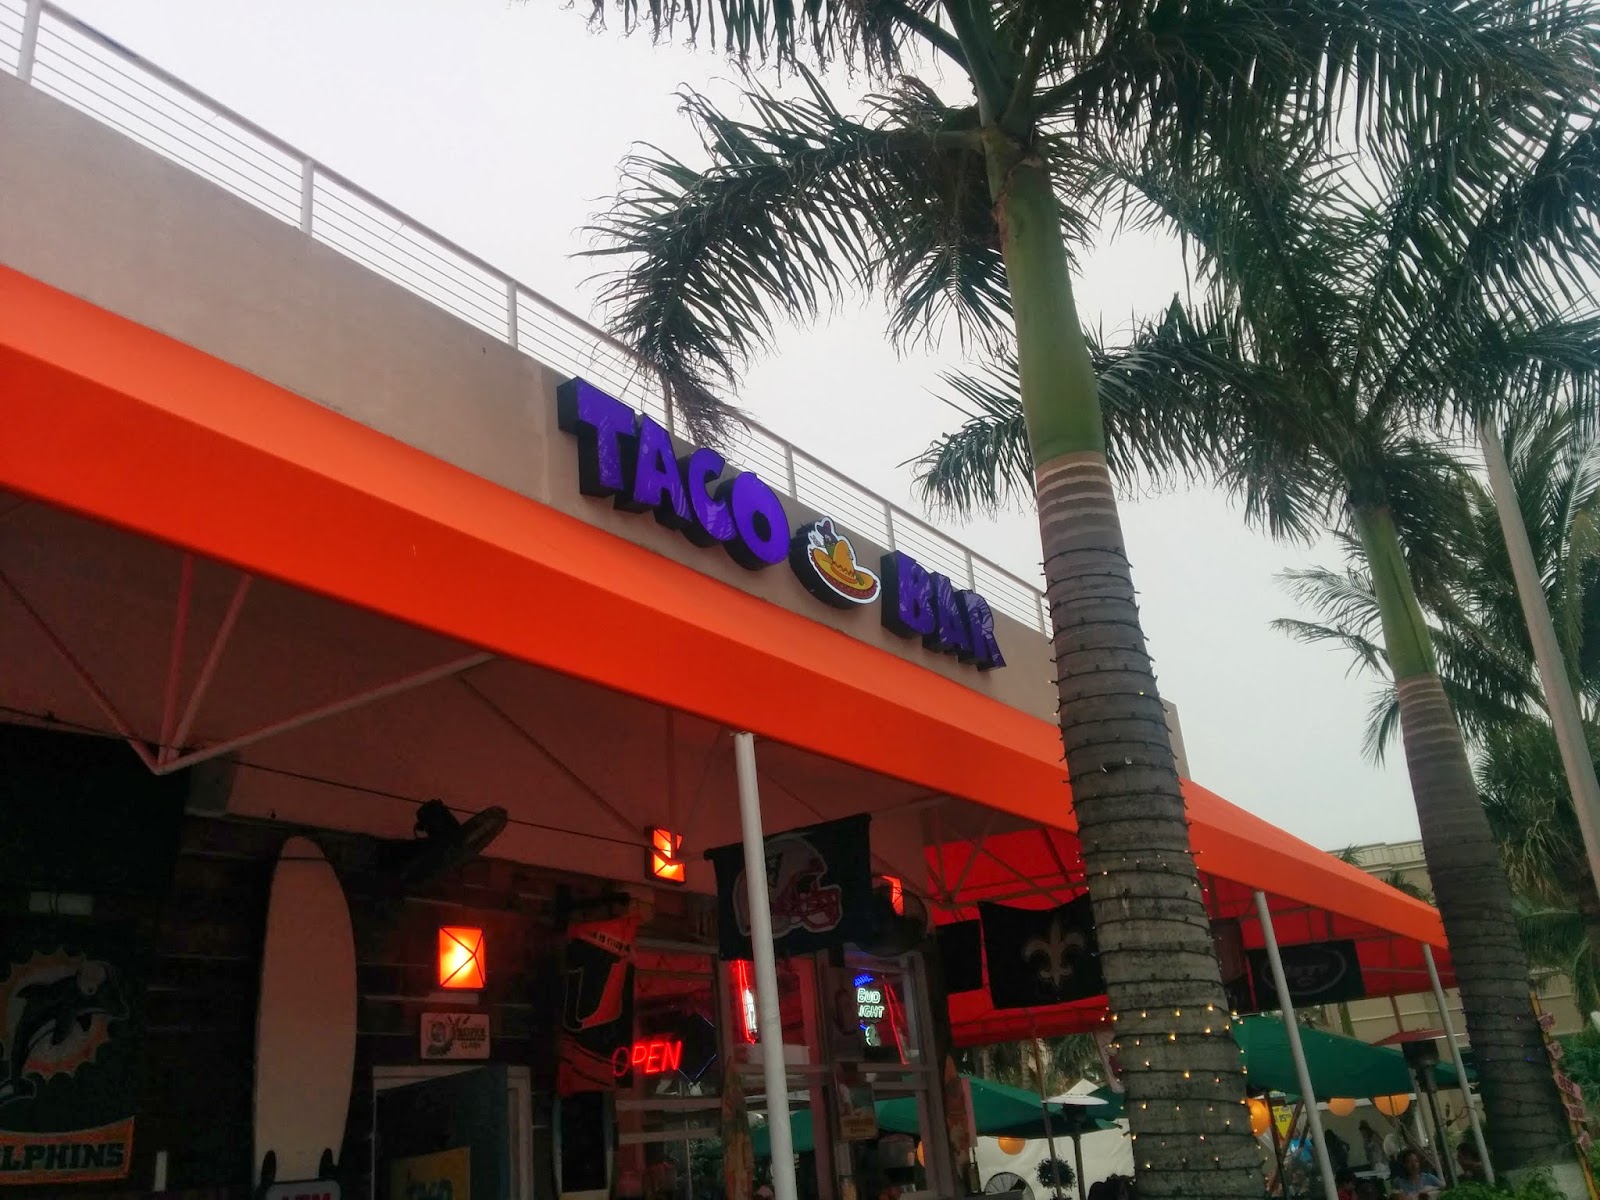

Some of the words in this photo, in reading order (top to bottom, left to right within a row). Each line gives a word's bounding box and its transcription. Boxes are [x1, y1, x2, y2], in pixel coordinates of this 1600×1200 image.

[562, 376, 790, 568] TACO
[886, 550, 1006, 671] BAR
[857, 987, 881, 1004] BUD
[612, 1040, 682, 1077] OPEN
